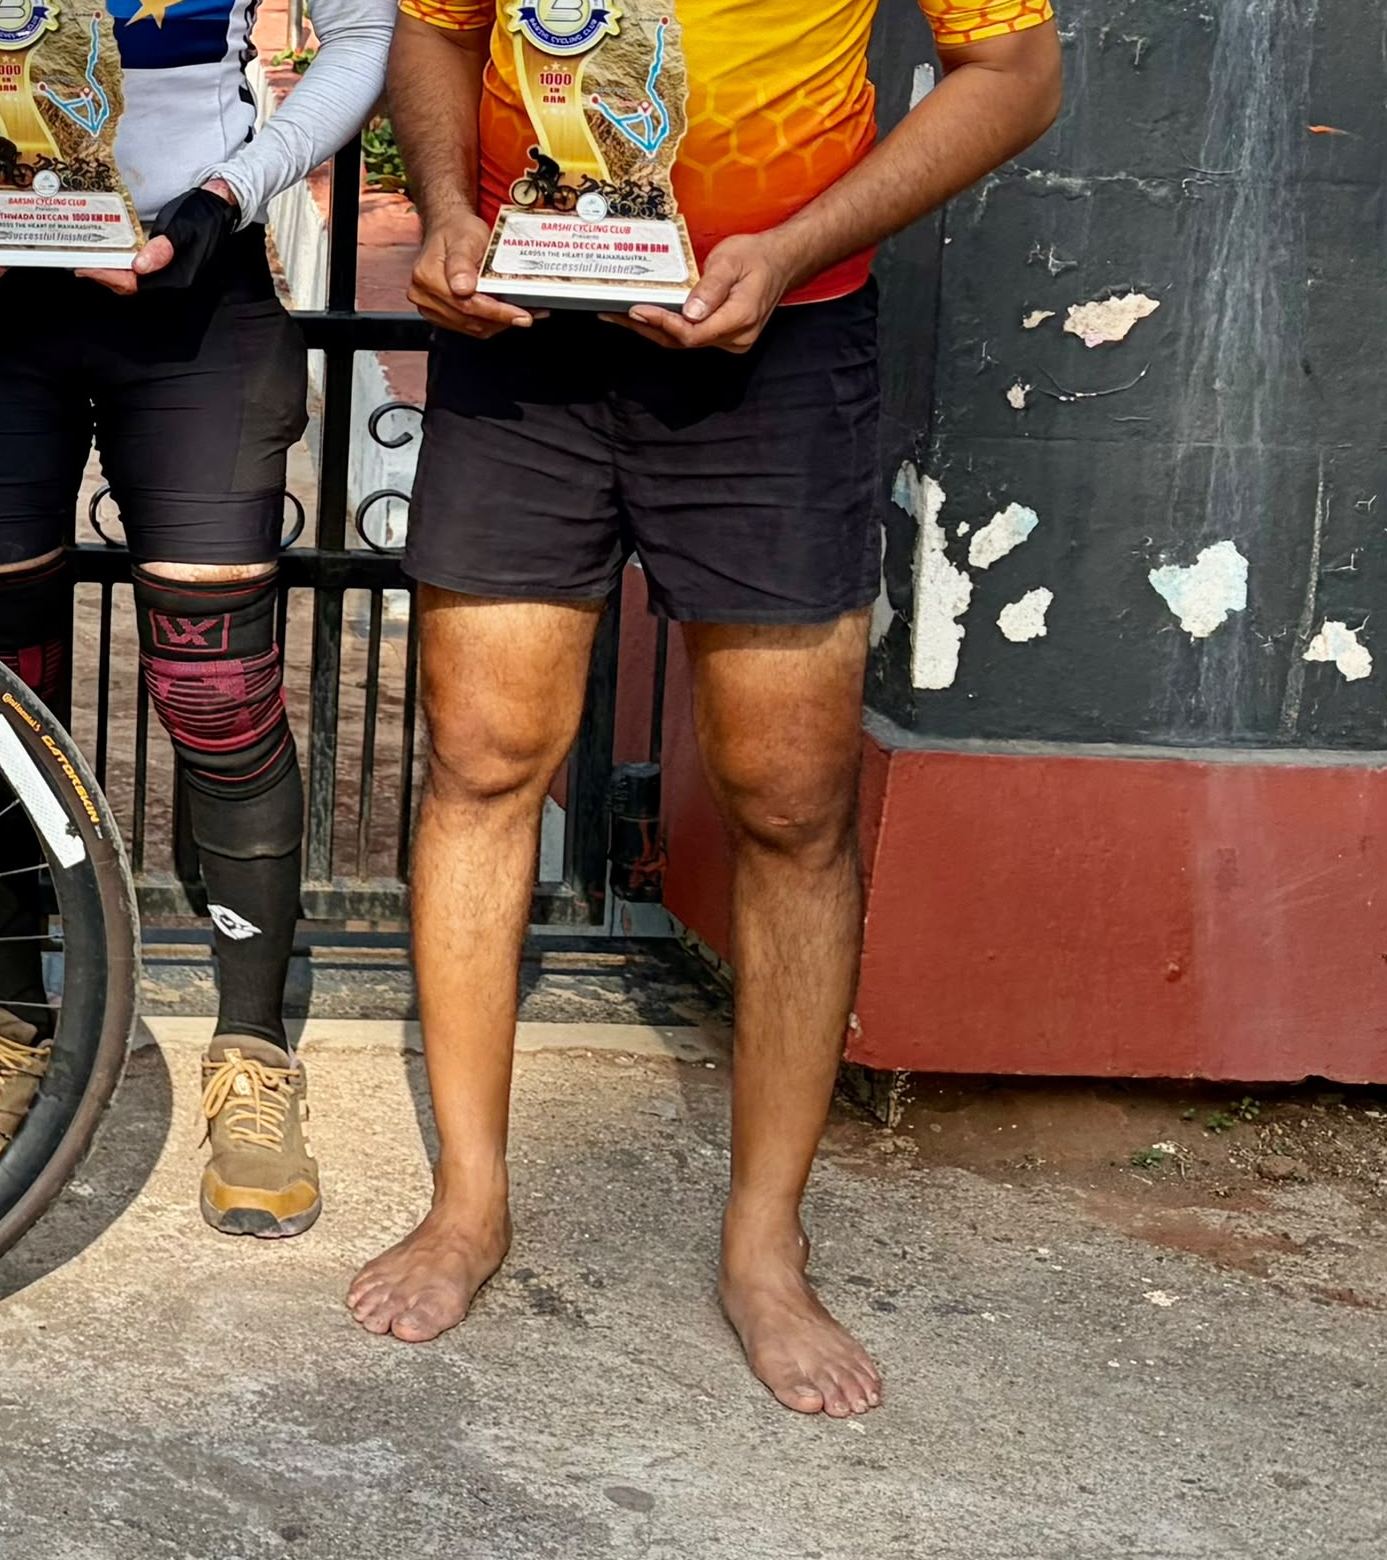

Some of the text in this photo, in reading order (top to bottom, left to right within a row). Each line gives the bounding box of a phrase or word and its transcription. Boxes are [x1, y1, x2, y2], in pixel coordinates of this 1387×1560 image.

[540, 73, 571, 86] 1000
[36, 198, 66, 206] CYCLING
[541, 223, 631, 234] BARSHI CYCLING CLUB
[503, 239, 570, 248] MARATHWADA
[573, 242, 609, 250] DECCAN
[614, 242, 633, 252] 1000
[41, 735, 100, 823] GATORSKIN
